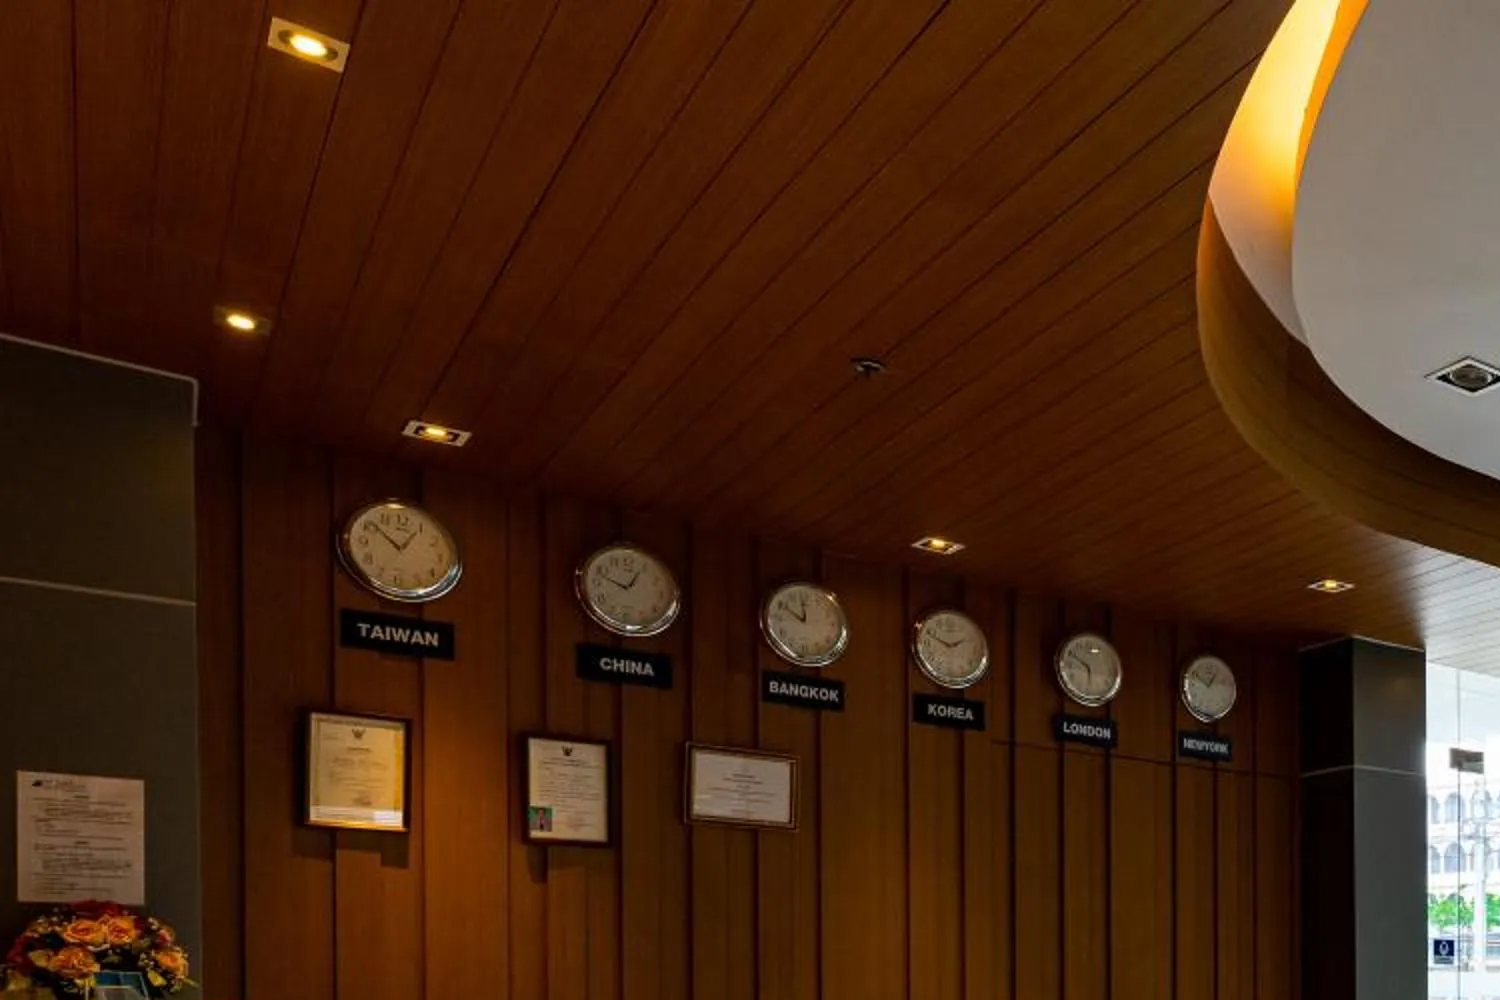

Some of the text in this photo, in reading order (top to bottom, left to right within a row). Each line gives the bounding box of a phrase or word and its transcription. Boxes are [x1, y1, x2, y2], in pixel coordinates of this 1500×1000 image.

[356, 622, 439, 646] TAIWAN
[600, 657, 655, 676] CHINA
[769, 681, 839, 702] BANGKOK
[927, 703, 974, 720] KOREA
[1063, 721, 1111, 739] LONDON
